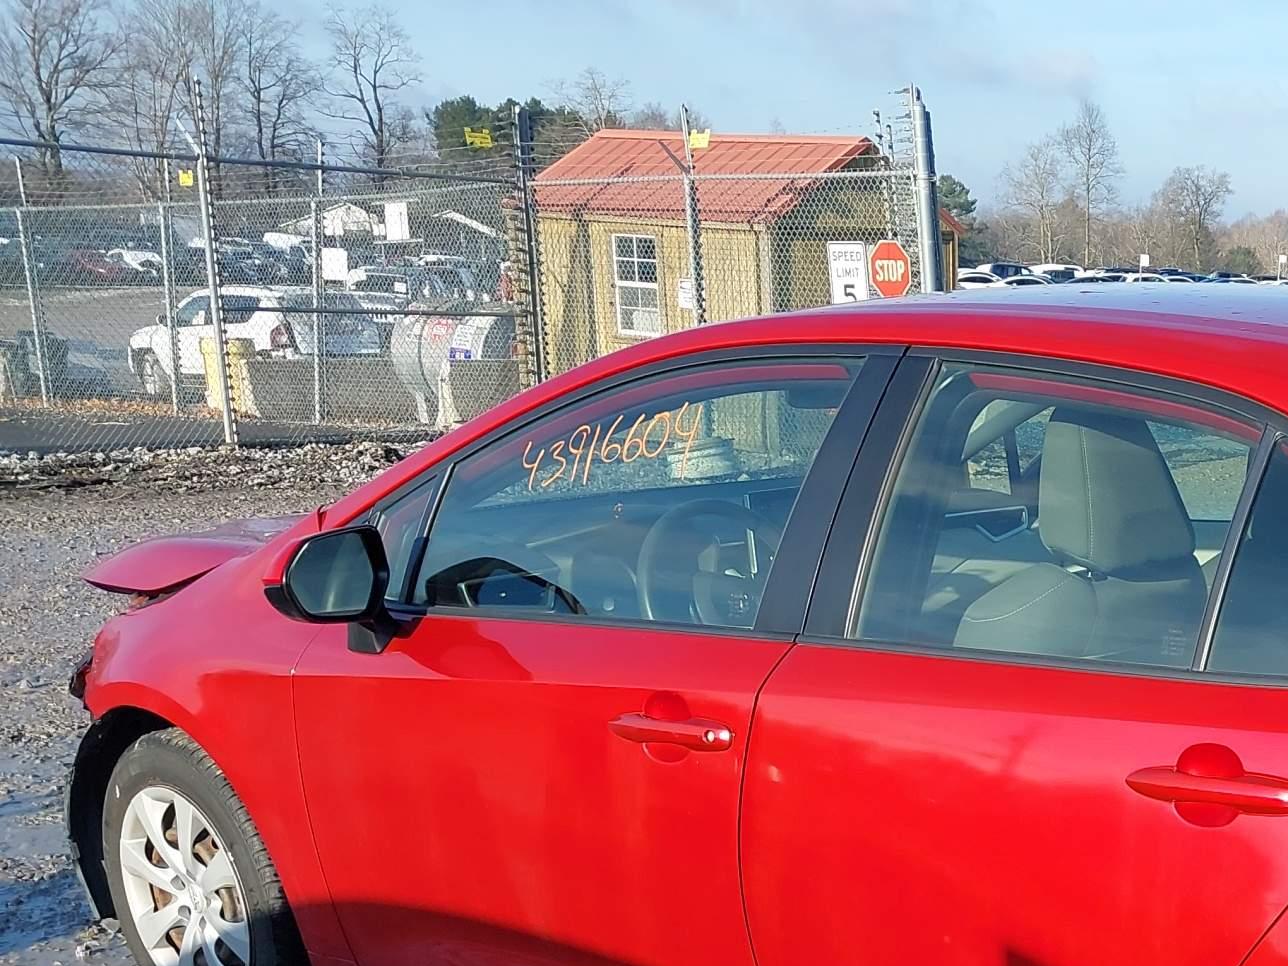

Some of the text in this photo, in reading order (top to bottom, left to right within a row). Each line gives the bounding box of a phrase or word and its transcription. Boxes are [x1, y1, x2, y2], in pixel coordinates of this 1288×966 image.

[832, 251, 861, 262] SPEED
[836, 267, 859, 278] LIMIT
[875, 260, 905, 282] STOP
[844, 284, 857, 302] 5
[523, 402, 703, 490] 43916604
